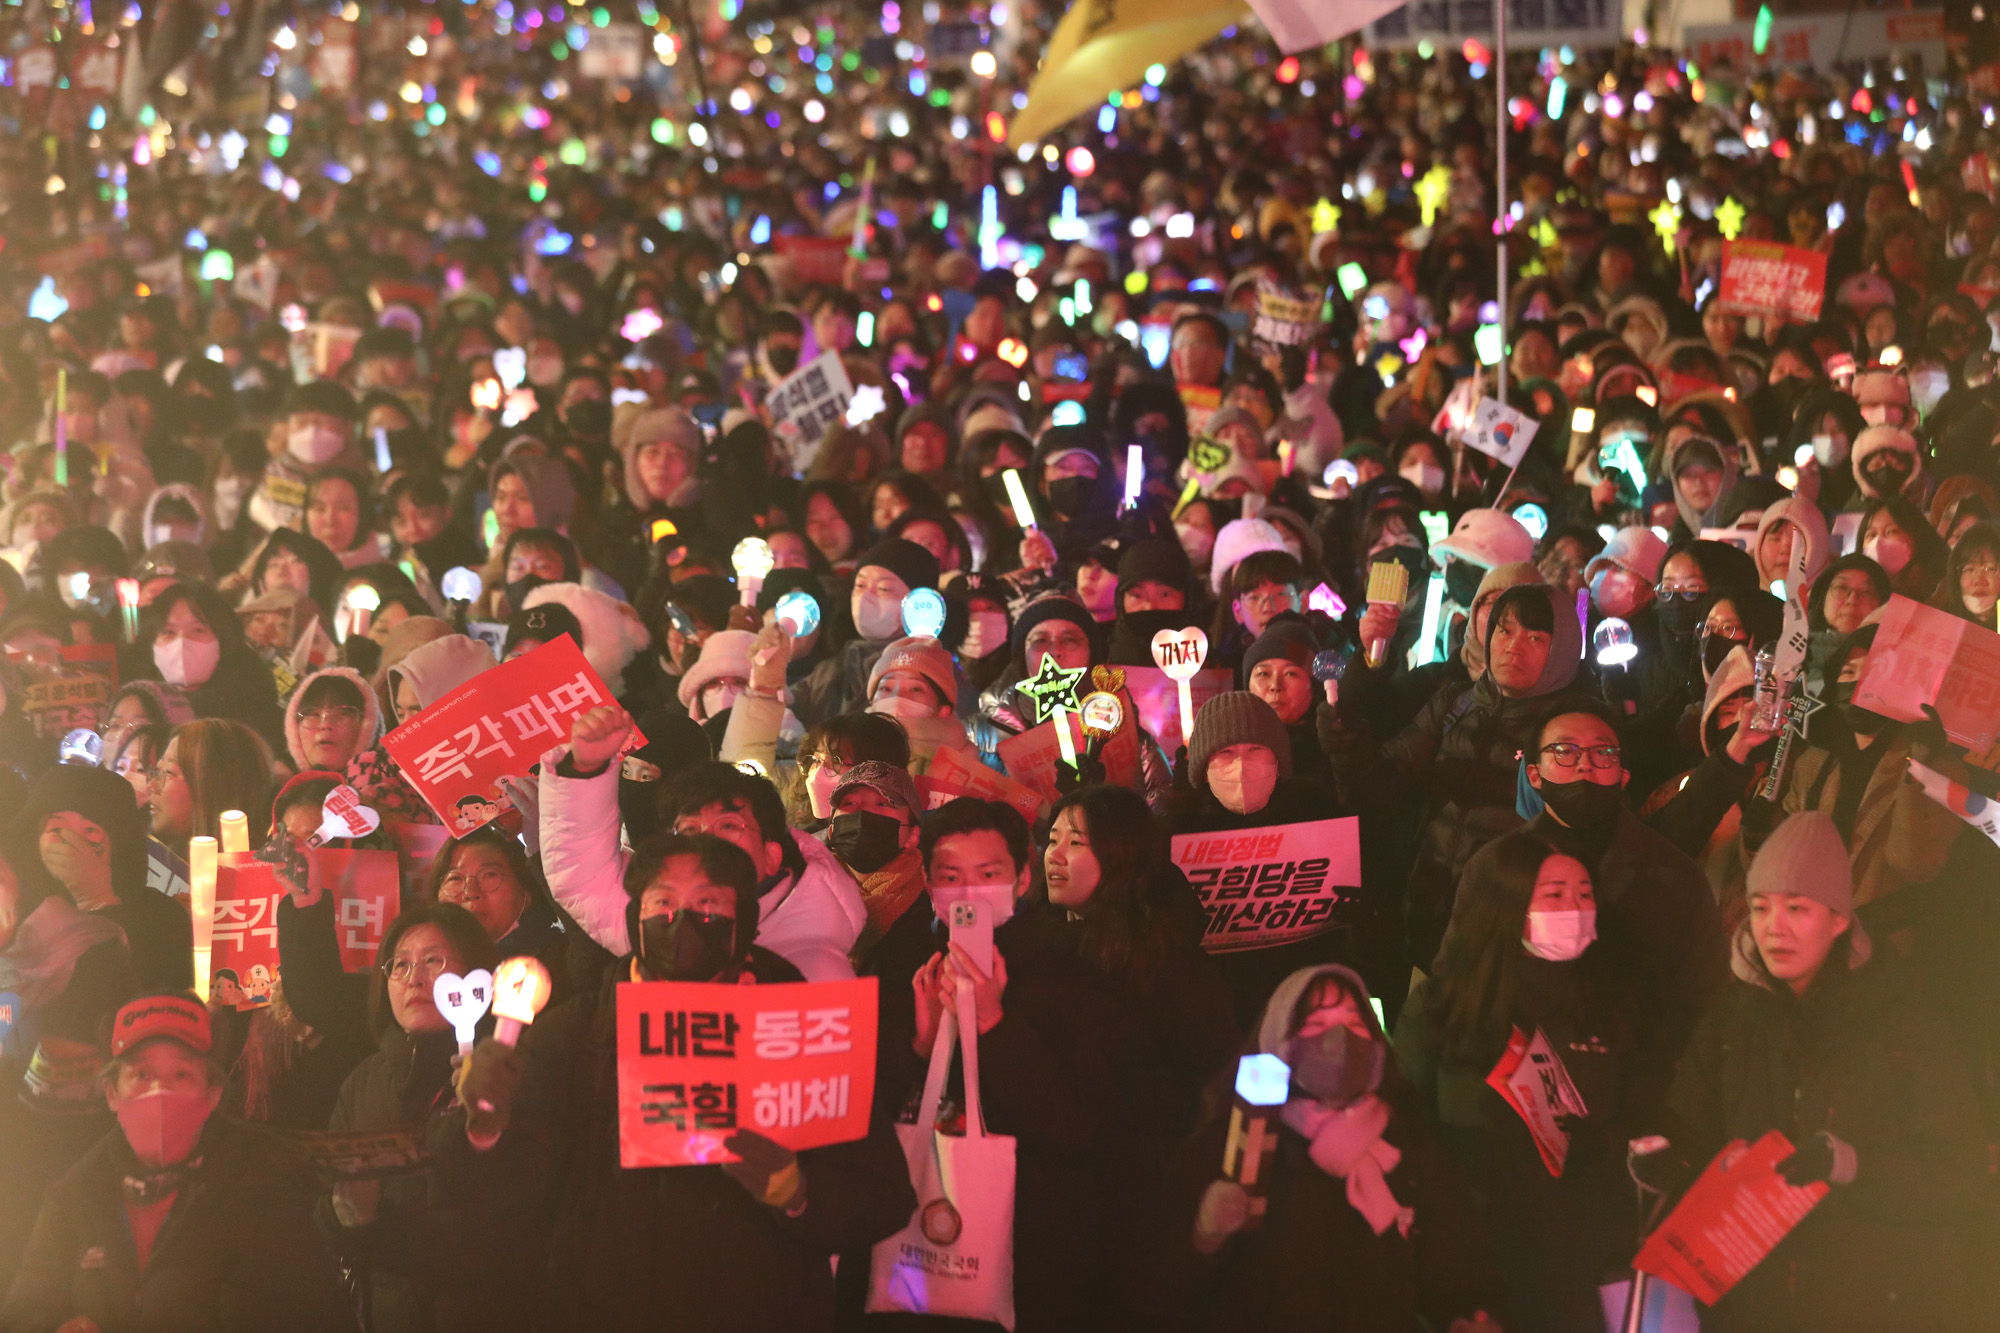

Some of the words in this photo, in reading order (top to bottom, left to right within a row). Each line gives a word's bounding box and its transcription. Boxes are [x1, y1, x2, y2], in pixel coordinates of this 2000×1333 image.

[413, 714, 516, 785] 즉각
[503, 671, 603, 742] 파면
[422, 687, 477, 724] www.nanum.com
[324, 794, 373, 836] 탄핵!
[1180, 832, 1284, 865] 내란정범
[639, 1010, 740, 1058] 내란
[753, 1007, 851, 1059] 동조
[640, 1082, 737, 1132] 국힘
[753, 1074, 850, 1128] 해체
